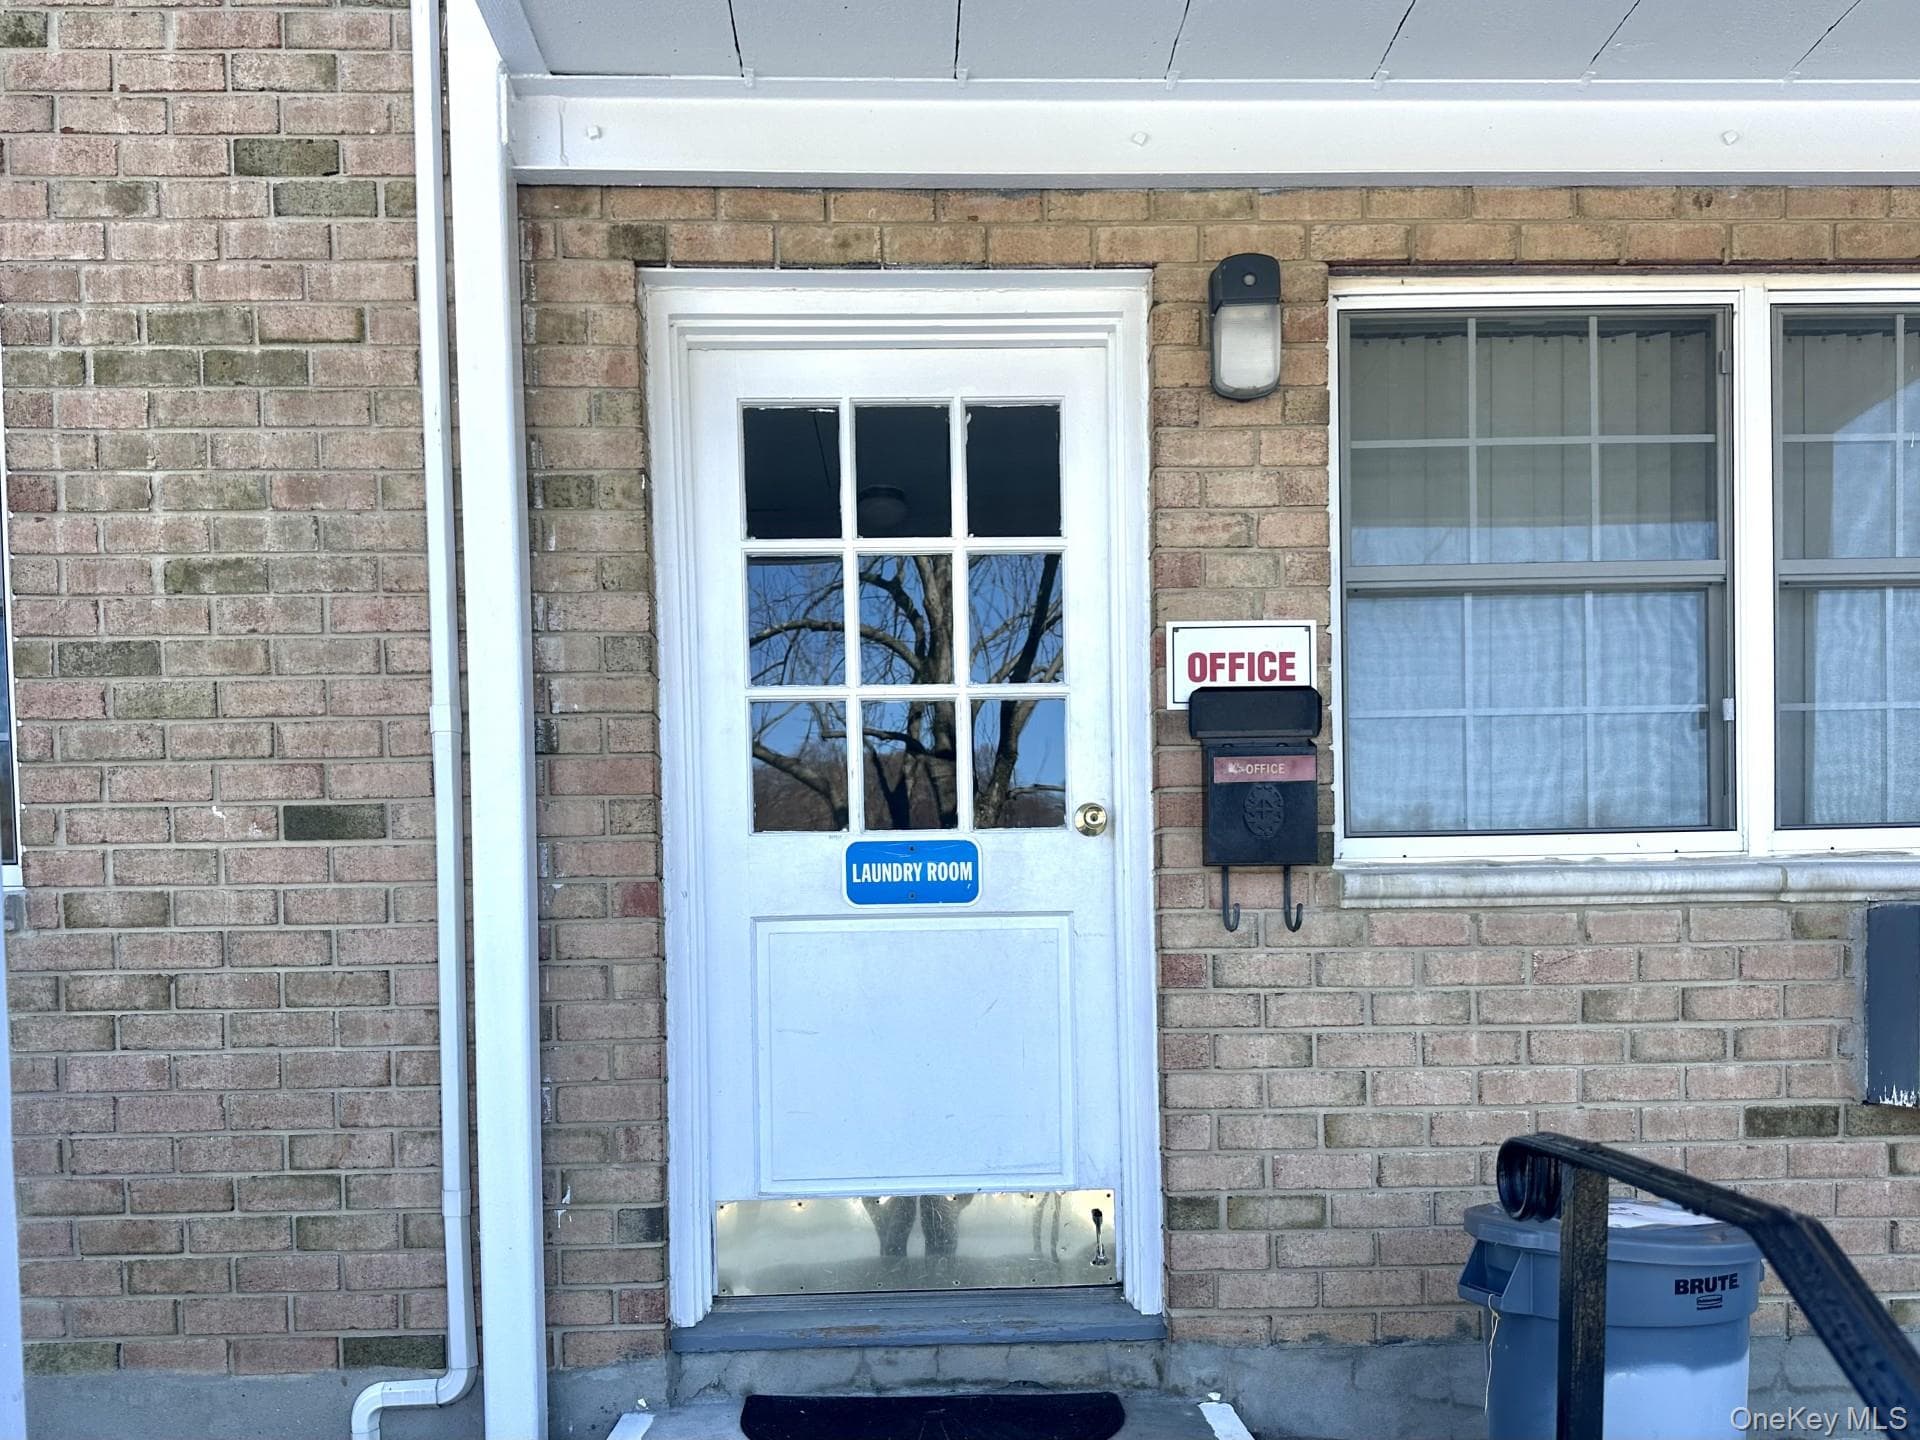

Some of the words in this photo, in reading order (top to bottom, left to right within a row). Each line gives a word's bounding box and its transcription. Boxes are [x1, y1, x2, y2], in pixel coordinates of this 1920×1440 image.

[1187, 651, 1296, 683] OFFICE
[852, 863, 922, 883] LAUNDRY
[927, 862, 973, 881] ROOM
[1674, 1272, 1739, 1295] BRUTE
